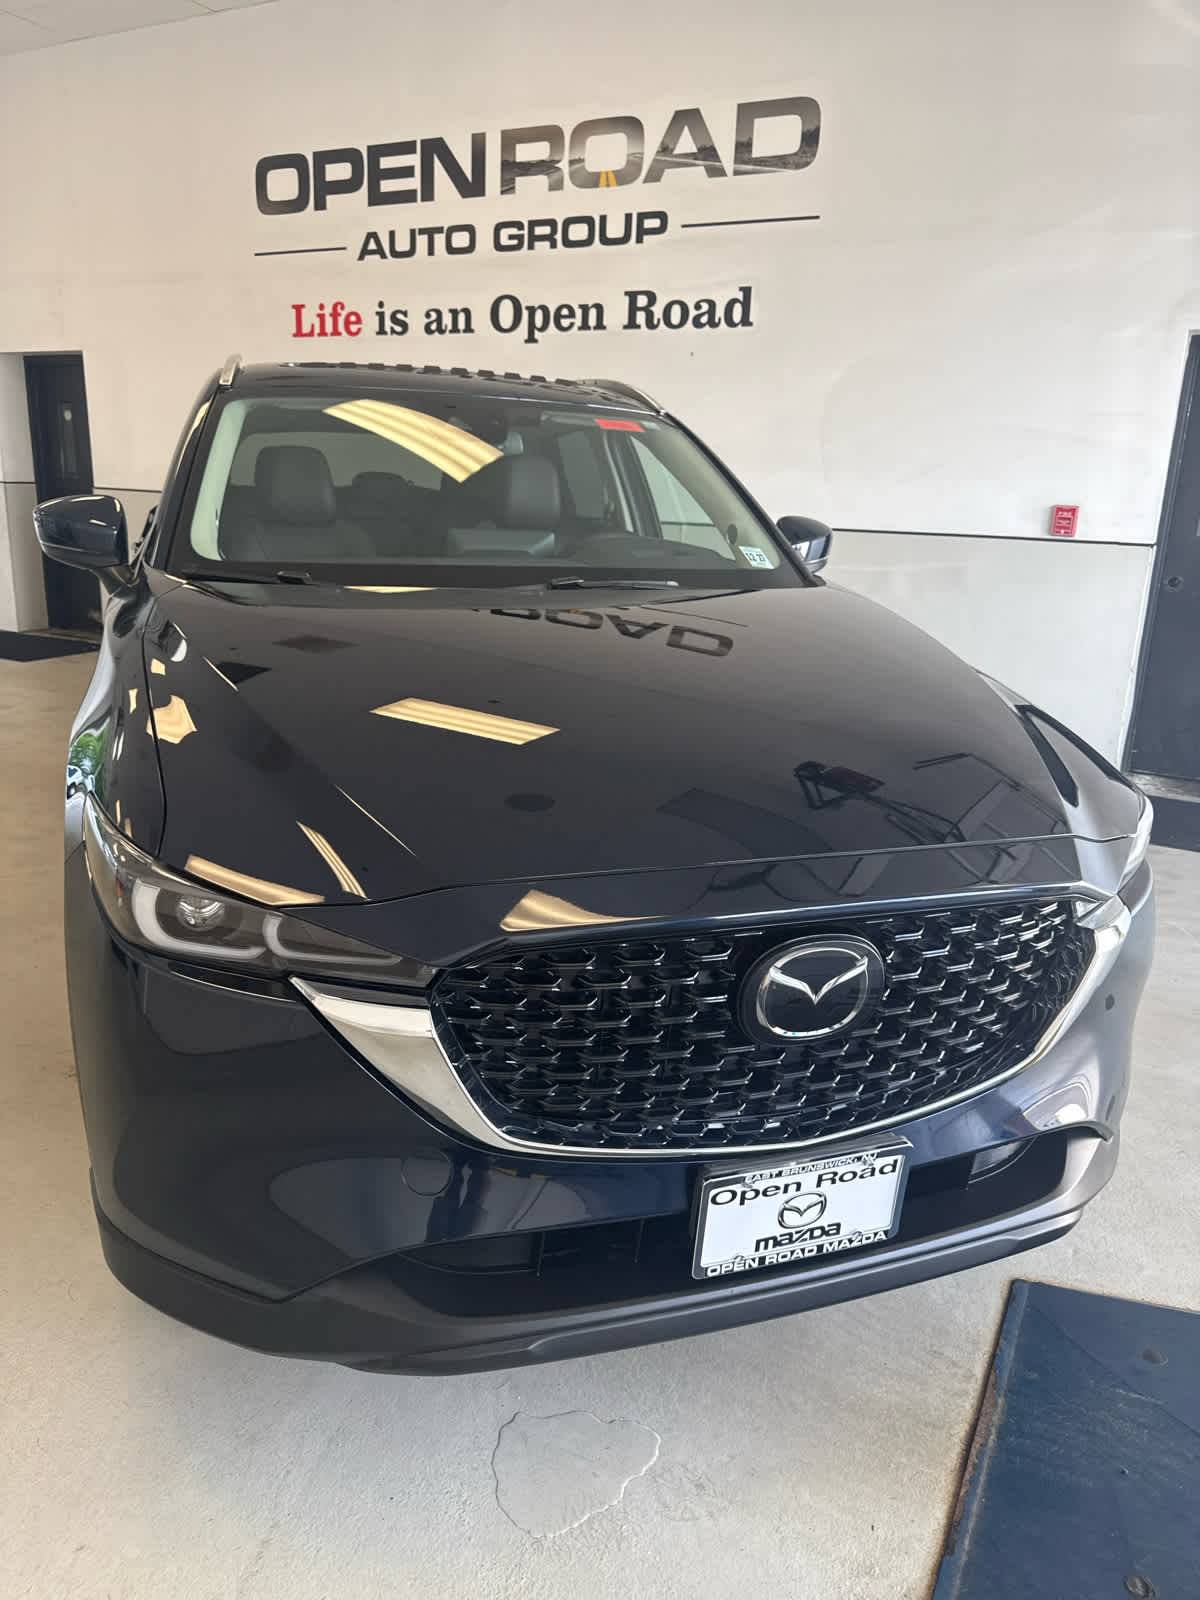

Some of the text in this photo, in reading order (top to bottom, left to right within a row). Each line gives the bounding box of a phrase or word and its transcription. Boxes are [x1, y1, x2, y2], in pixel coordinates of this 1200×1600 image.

[255, 96, 822, 216] OPEN ROAD
[357, 210, 668, 261] AUTO GROUP
[291, 286, 753, 343] Life is an Open Road
[710, 1159, 898, 1206] Open Road
[745, 1171, 781, 1182] EAST
[707, 1230, 888, 1277] OPEN ROAD MAZDA
[754, 1222, 842, 1252] mazda
